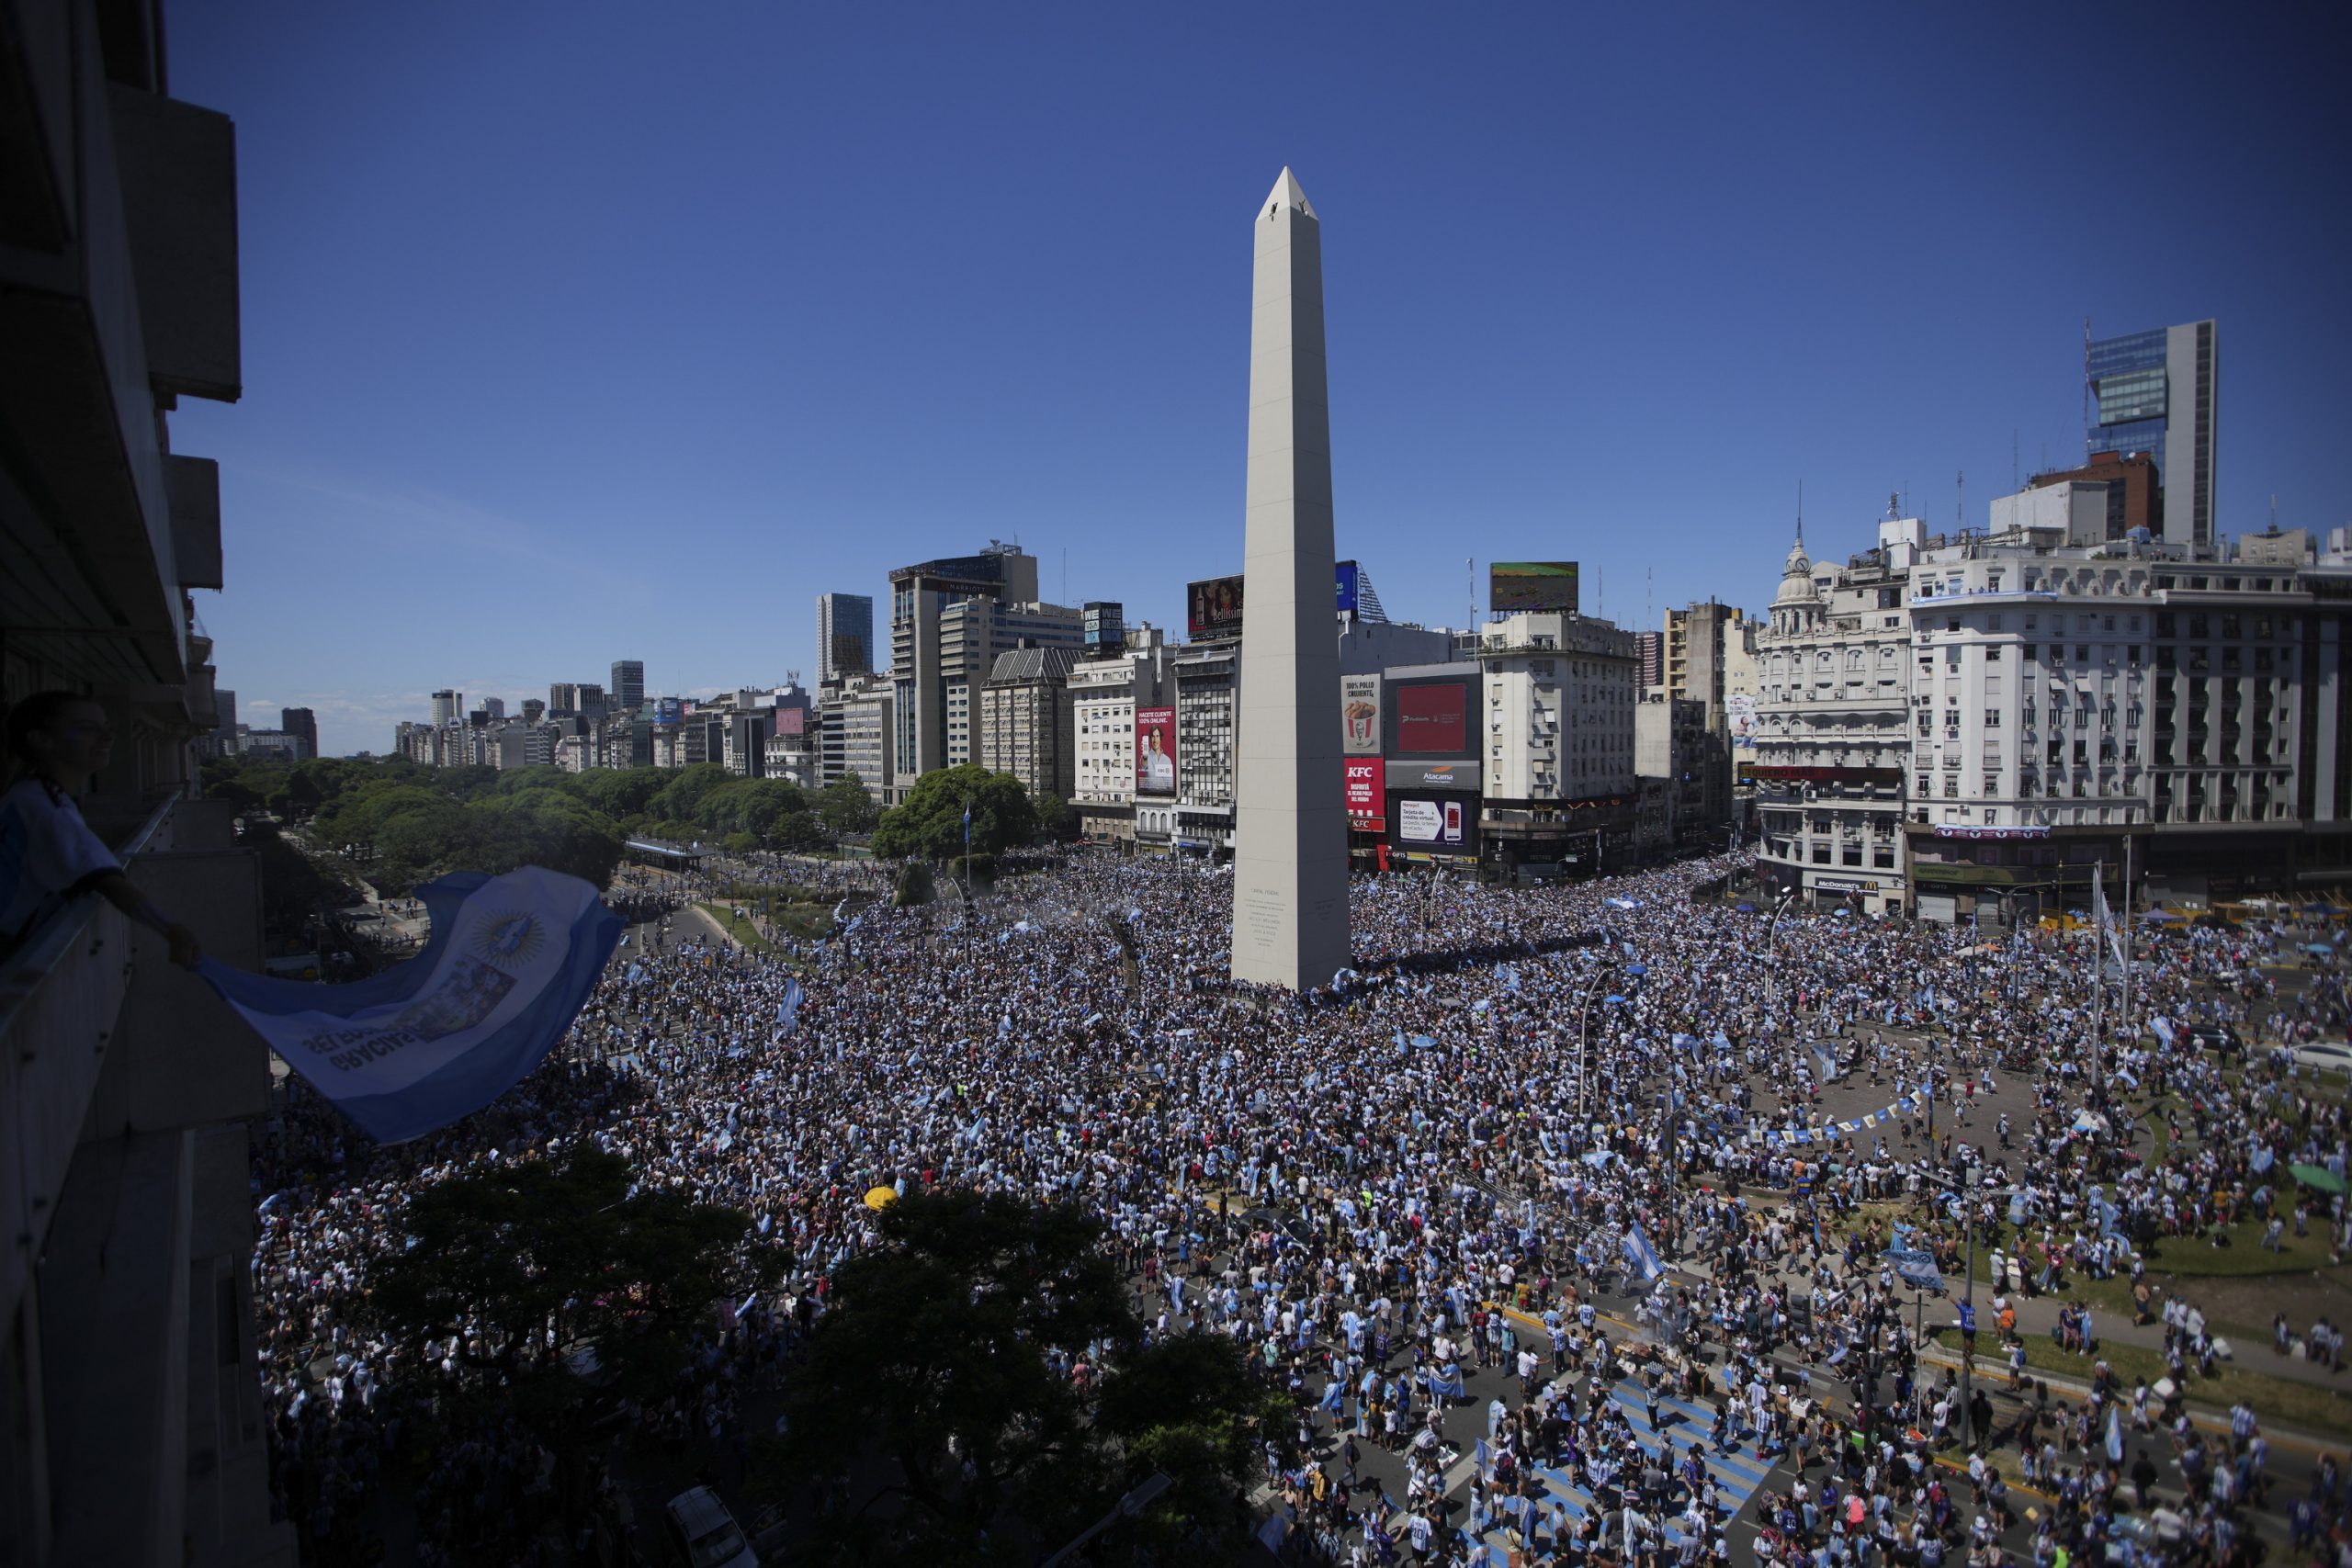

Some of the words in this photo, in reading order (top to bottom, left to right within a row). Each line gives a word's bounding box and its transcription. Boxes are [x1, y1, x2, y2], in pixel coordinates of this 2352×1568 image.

[950, 584, 985, 592] MARRIOTT
[1085, 610, 1099, 620] WE
[1102, 608, 1121, 618] WE
[1347, 767, 1373, 777] KFC
[1751, 768, 1788, 777] QUIERO
[1818, 881, 1860, 889] McDonald's
[1376, 1339, 1384, 1349] 10
[1787, 1518, 1796, 1529] 10
[1413, 1528, 1423, 1540] 10
